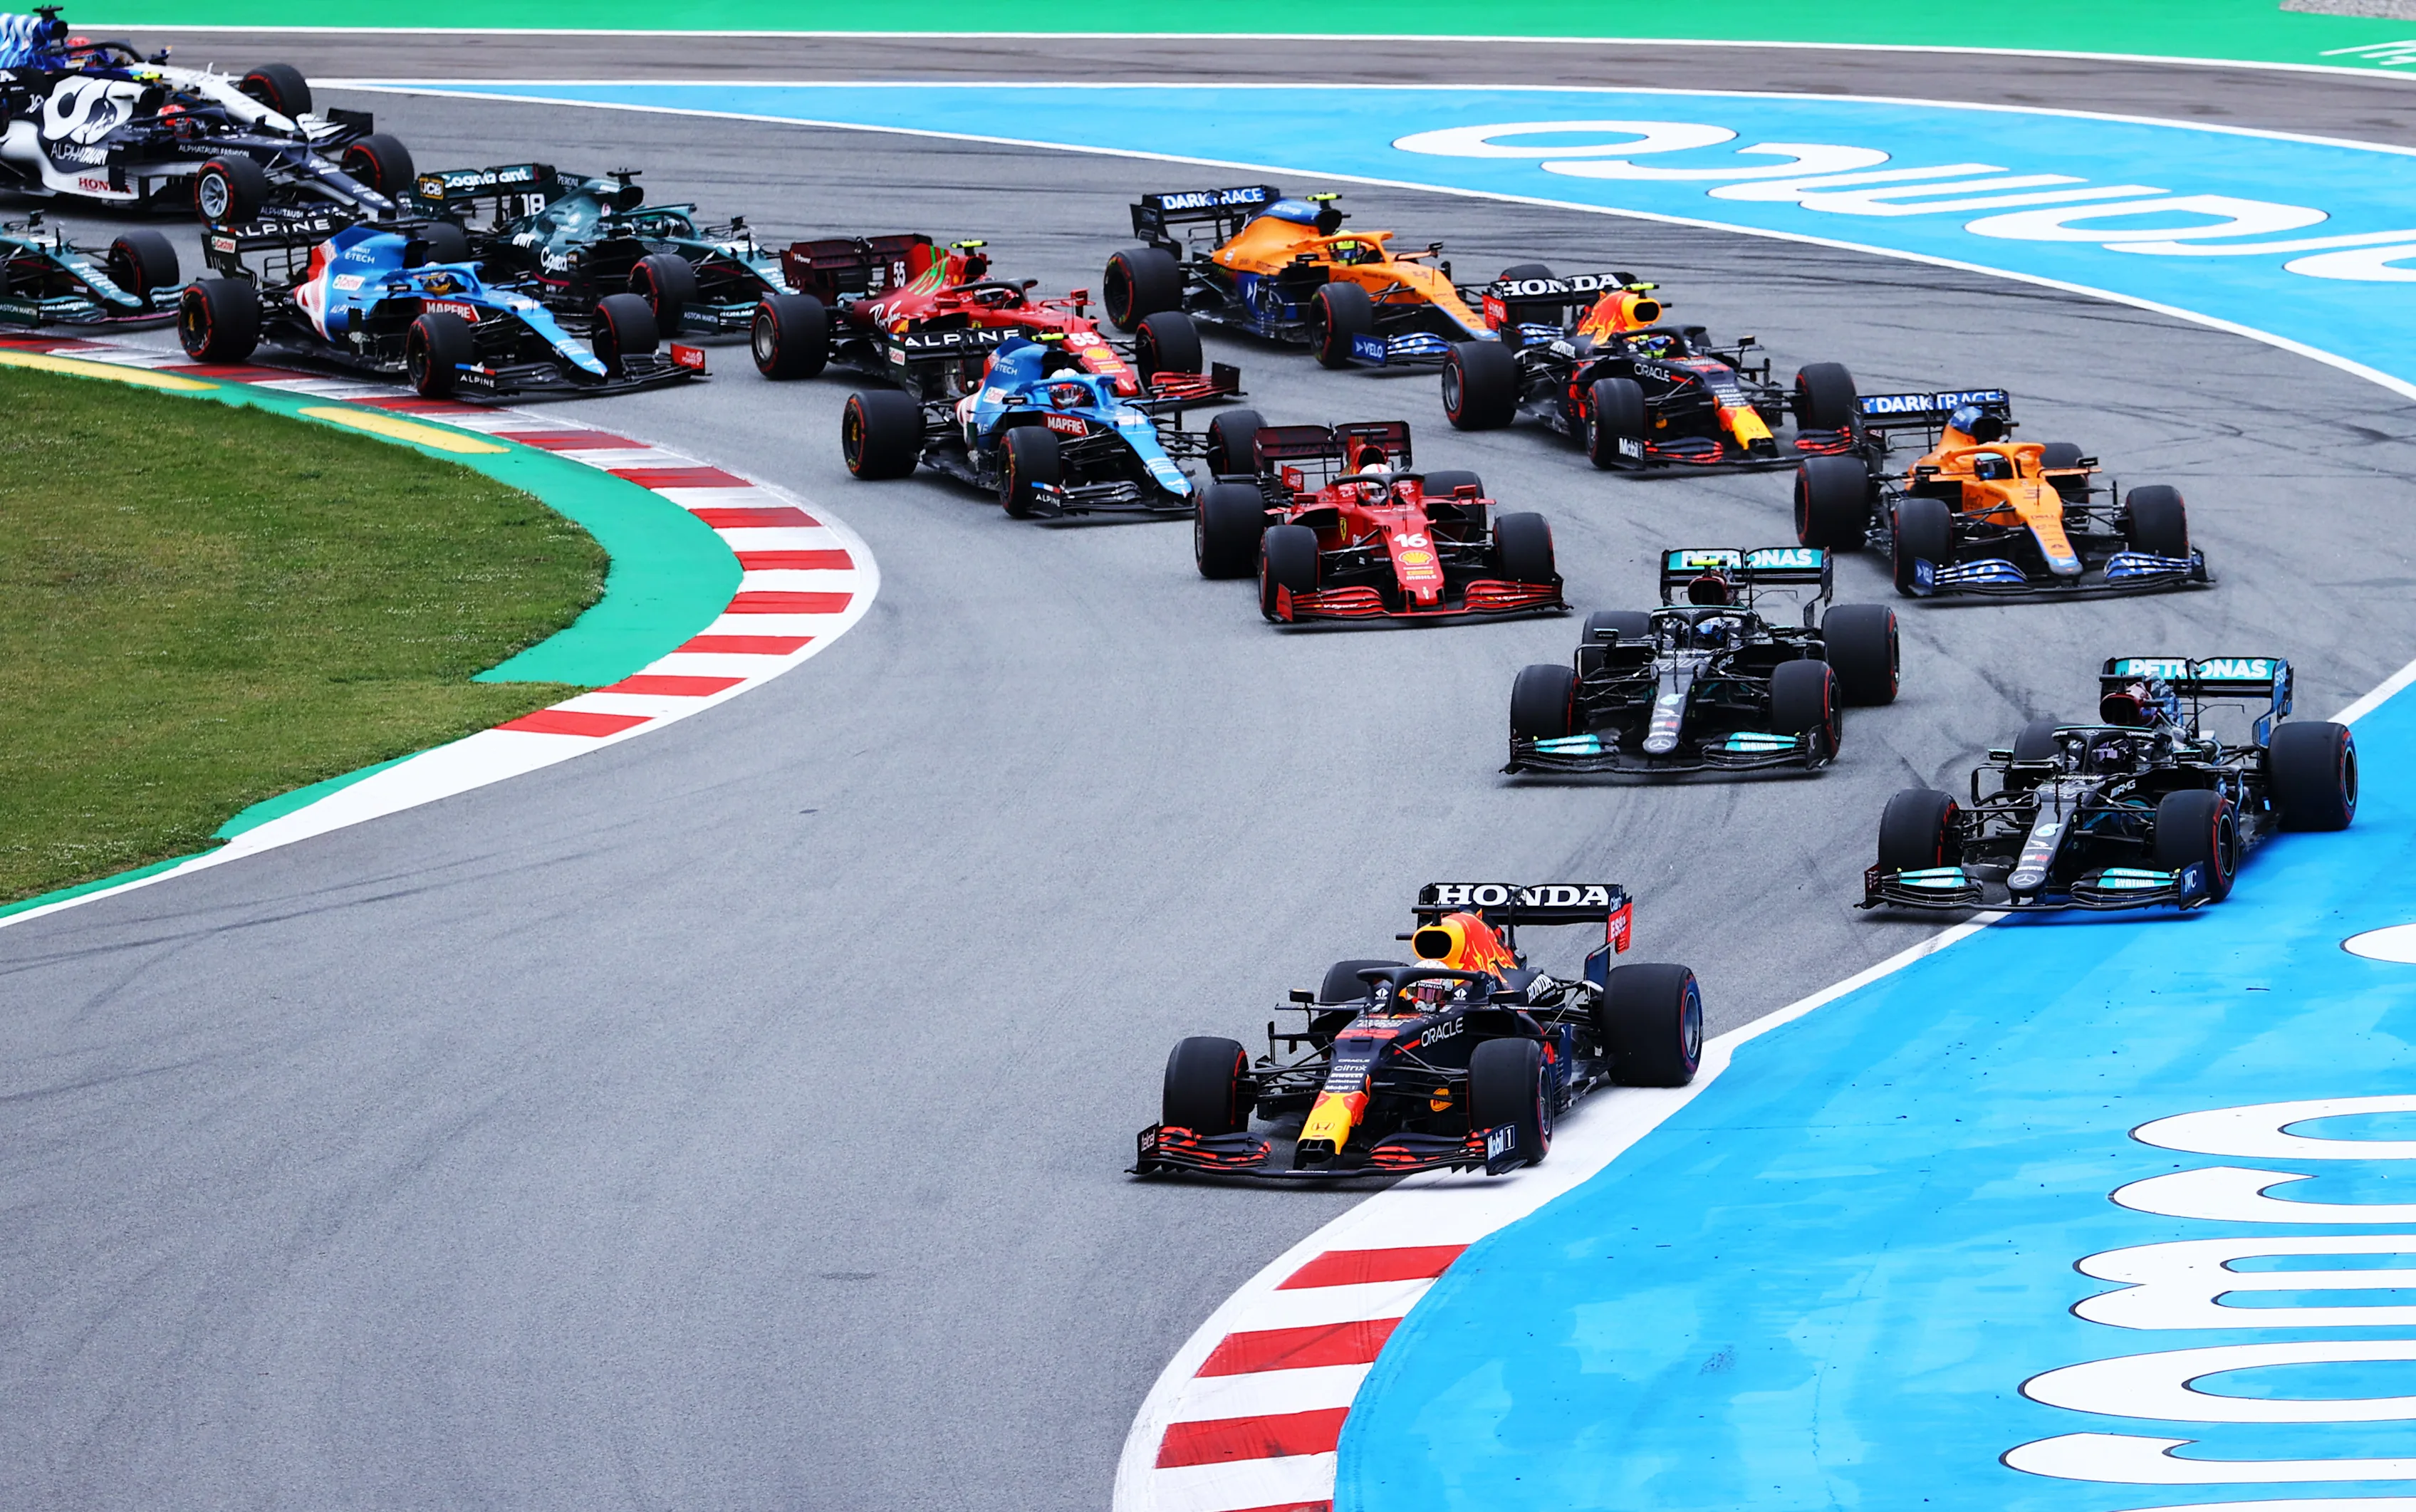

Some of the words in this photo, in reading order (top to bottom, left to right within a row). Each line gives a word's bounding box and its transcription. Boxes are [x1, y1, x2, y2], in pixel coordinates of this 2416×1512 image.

[51, 142, 108, 165] ALPHATAURI
[79, 177, 132, 194] HON
[422, 182, 442, 196] JCB
[521, 194, 545, 217] 18
[893, 261, 906, 288] 55
[427, 302, 471, 319] MAPFRE
[905, 328, 1020, 347] ALPINE
[1068, 331, 1100, 346] 55
[1363, 341, 1383, 358] VELO
[460, 374, 495, 387] ALPINE
[1634, 363, 1670, 382] ORACLE
[1047, 415, 1083, 434] MAPFRE
[1036, 494, 1061, 508] ALPINE
[1393, 533, 1428, 548] 16
[1436, 885, 1609, 906] HONDA
[1526, 974, 1555, 1003] HONDA
[1421, 1017, 1464, 1047] ORACLE
[1488, 1128, 1504, 1160] Mobil
